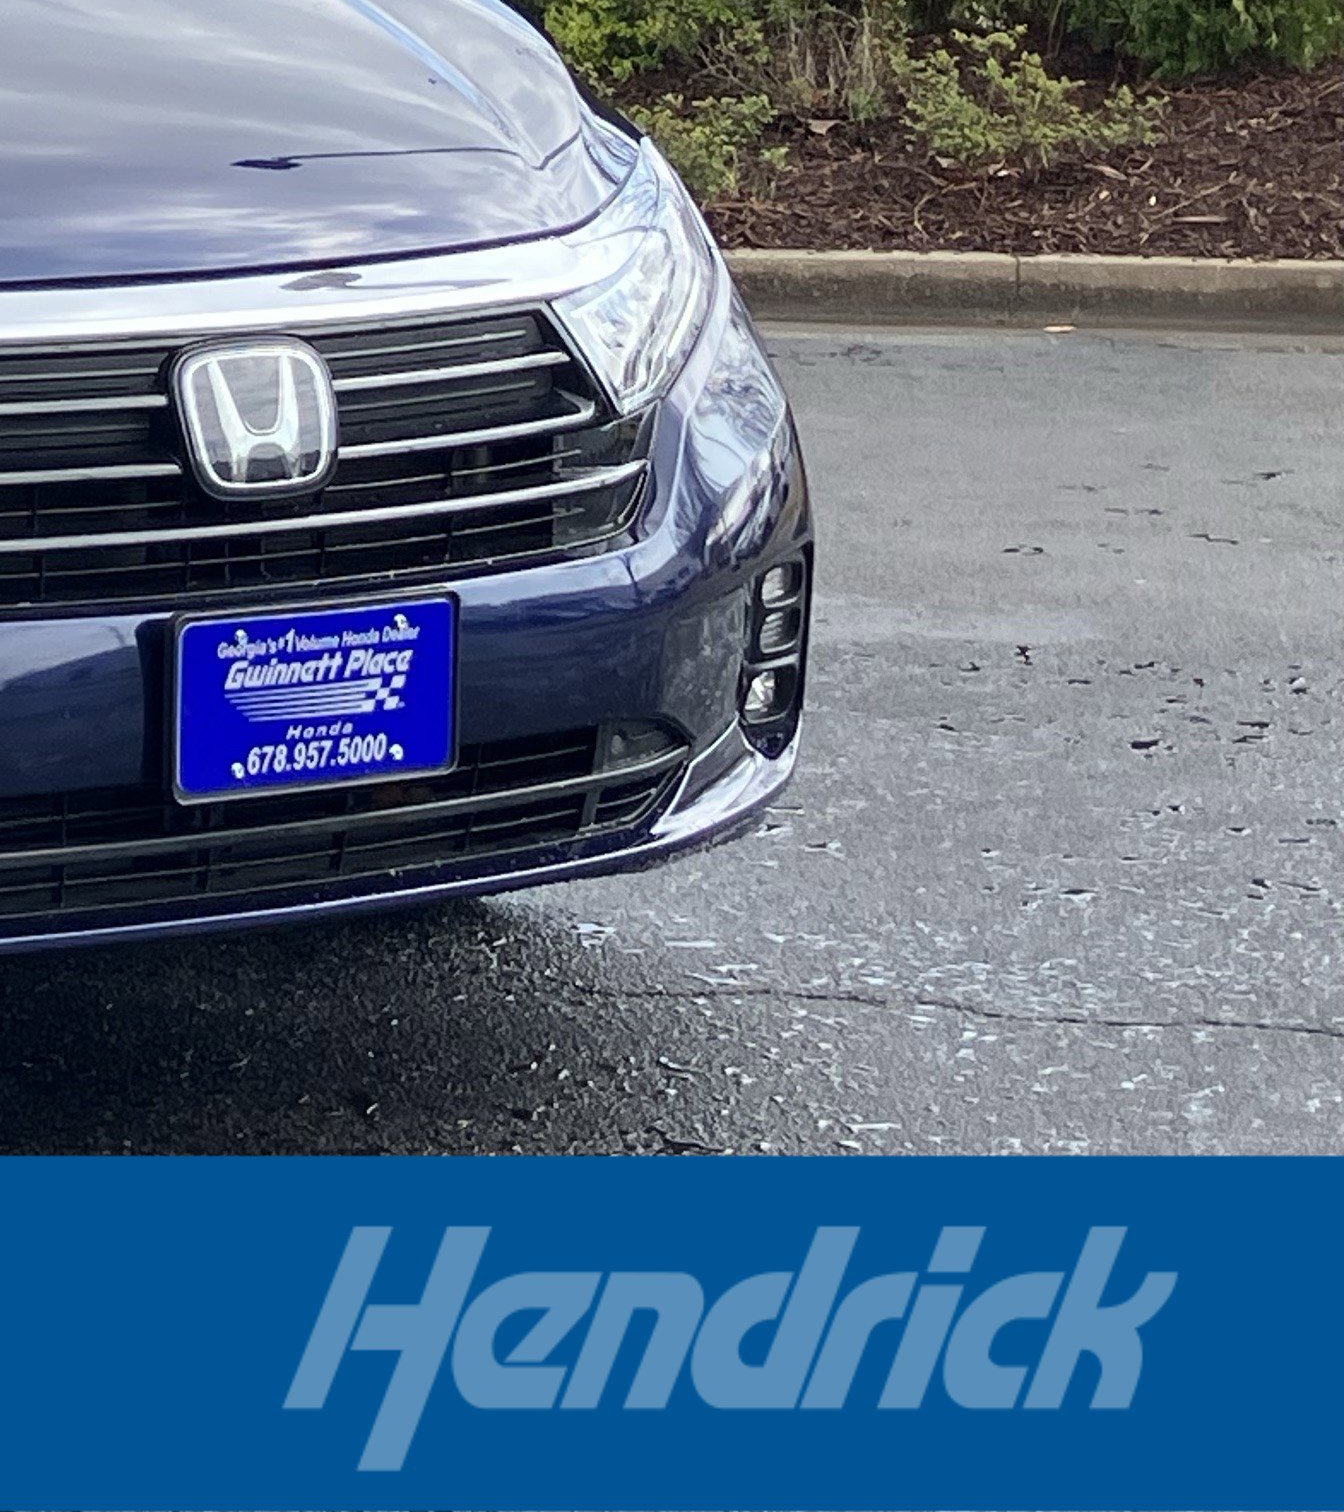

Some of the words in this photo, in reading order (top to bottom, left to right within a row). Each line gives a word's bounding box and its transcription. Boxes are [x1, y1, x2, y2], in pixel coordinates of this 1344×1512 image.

[341, 628, 380, 647] Honda
[224, 651, 343, 690] Gwinnett
[344, 648, 414, 678] Place
[286, 721, 353, 740] Honda
[246, 733, 388, 776] 678.957.5000
